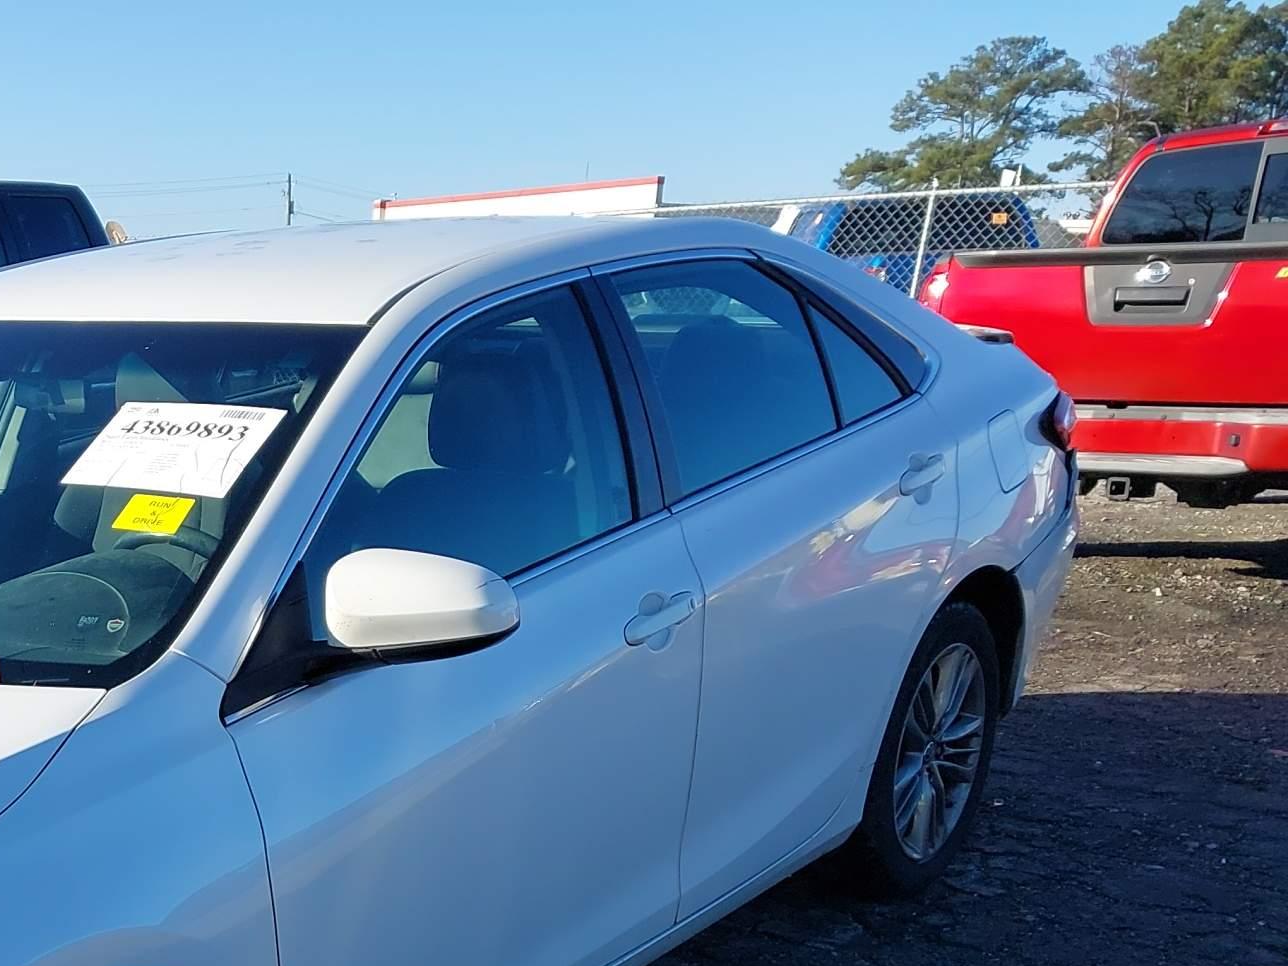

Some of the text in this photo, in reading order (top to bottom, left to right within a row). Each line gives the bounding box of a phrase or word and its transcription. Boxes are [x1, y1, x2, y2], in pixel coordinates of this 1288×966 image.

[120, 418, 250, 442] 43869893
[149, 500, 172, 509] RUN
[132, 516, 165, 527] DRIVE
